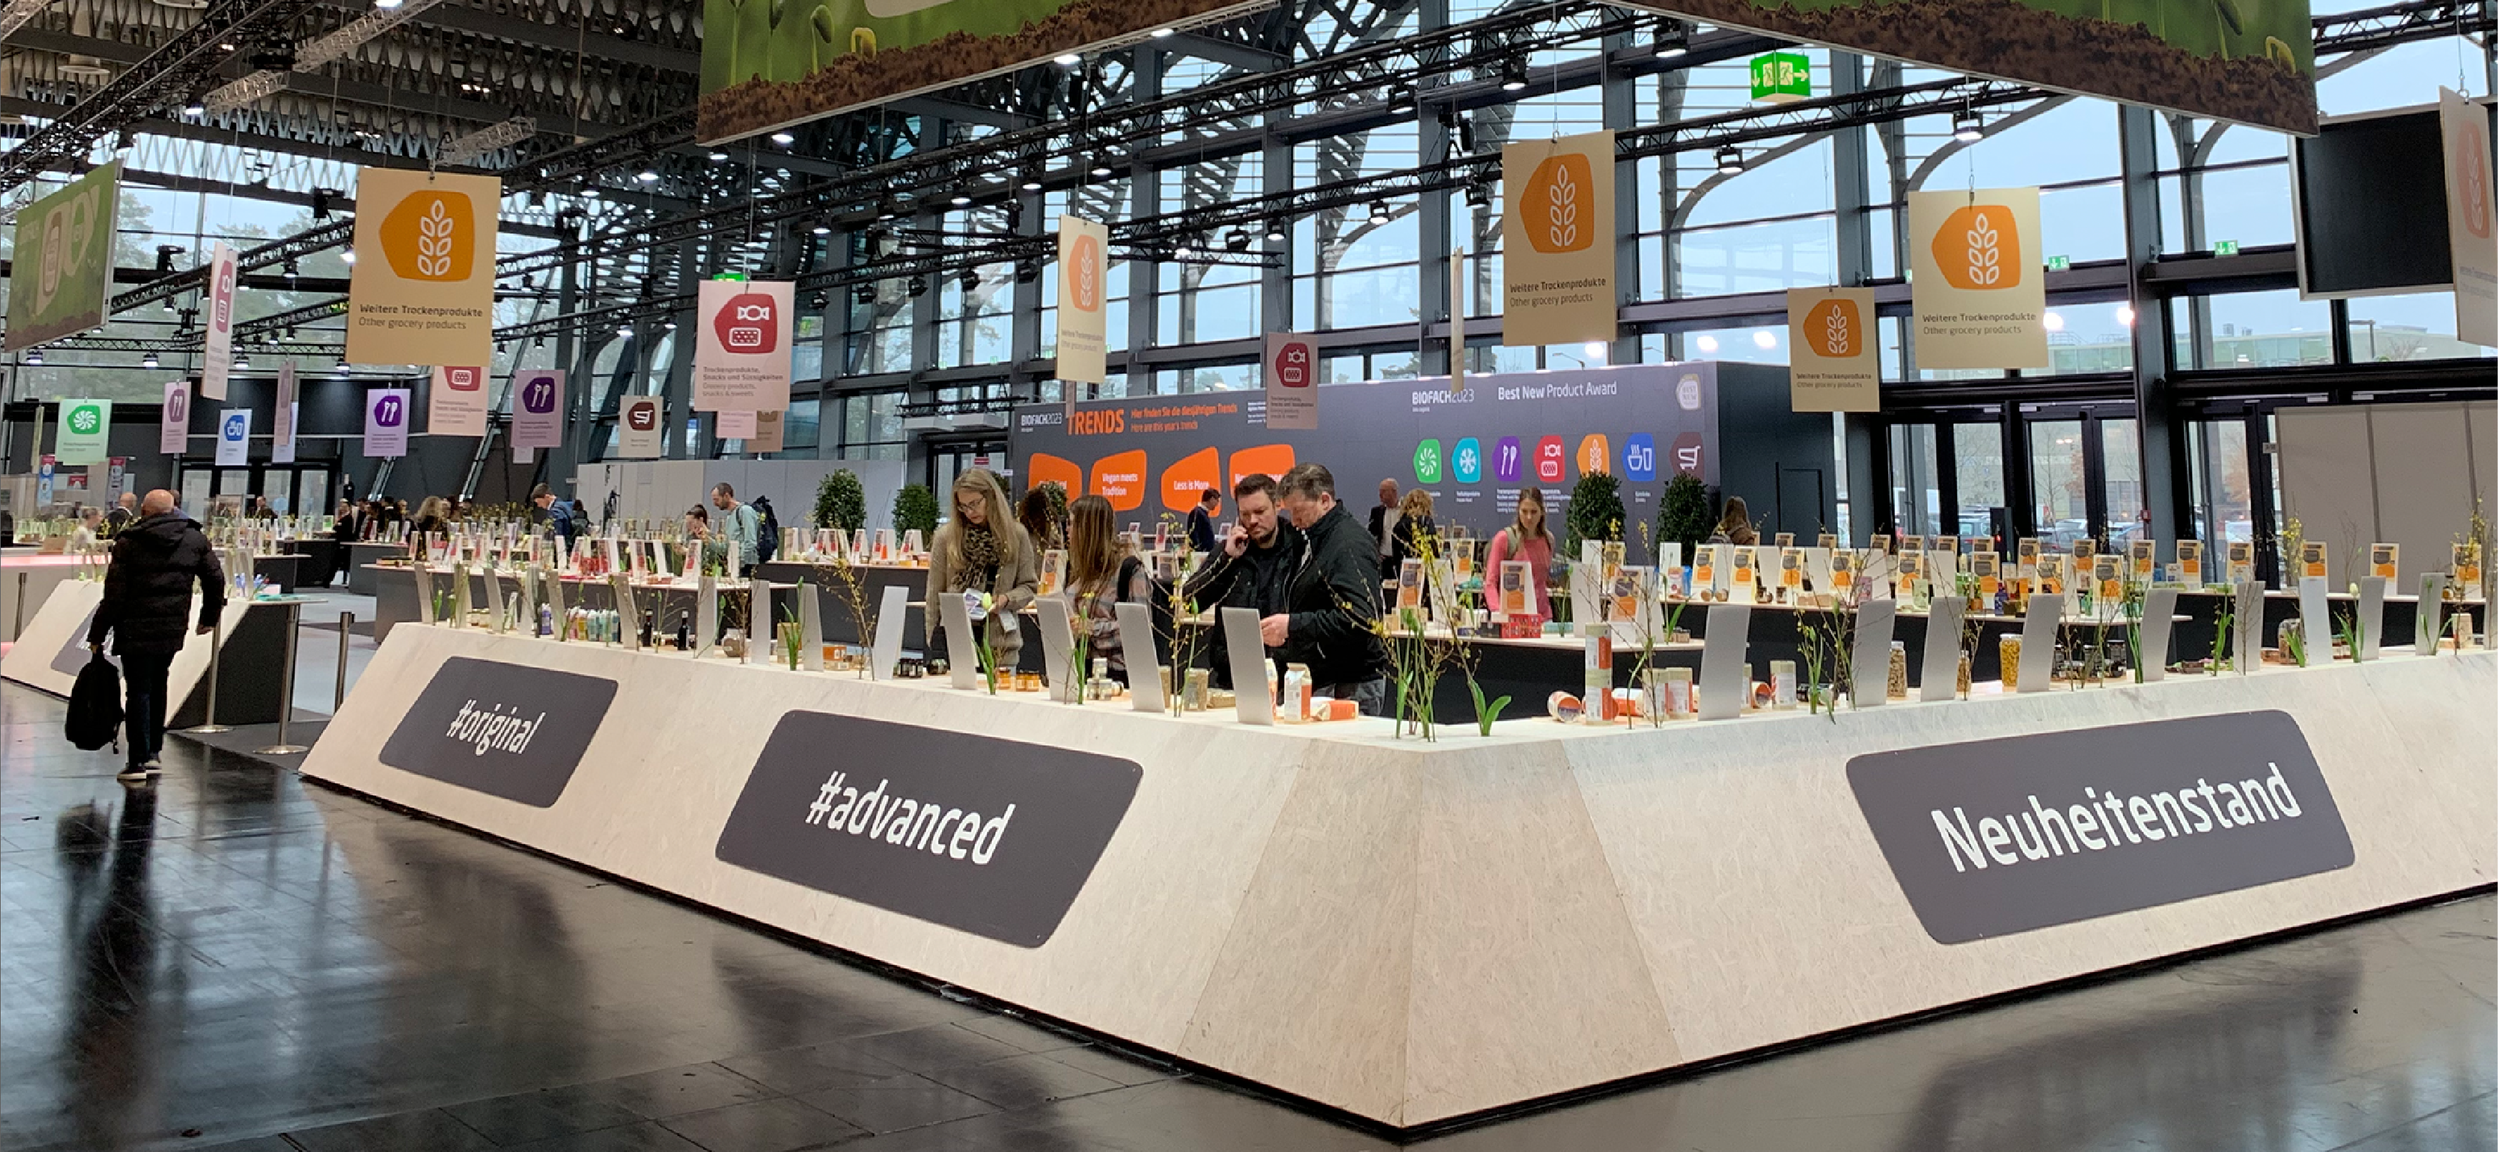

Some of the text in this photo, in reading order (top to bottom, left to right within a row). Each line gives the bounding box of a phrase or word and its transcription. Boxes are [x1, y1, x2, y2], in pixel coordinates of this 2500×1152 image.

[1510, 278, 1606, 293] Weitere Trockenprodukte
[1510, 293, 1593, 308] Other grocery products
[360, 304, 483, 317] Weitere Trockenprodukte
[358, 317, 467, 329] Other grocery products
[1922, 313, 2036, 322] Weitere Trockenprodukte
[1923, 326, 2021, 336] Other grocery products
[1498, 380, 1617, 400] Best New Product Award
[1217, 402, 1238, 414] Trends
[1067, 408, 1125, 436] TRENDS
[1102, 473, 1138, 484] Vegan meets
[1174, 480, 1187, 490] Less
[1188, 480, 1194, 490] is
[1102, 486, 1127, 496] Tradition
[446, 699, 546, 757] #original
[805, 770, 1016, 865] #advanced
[1930, 762, 2302, 873] Neuheitenstand
